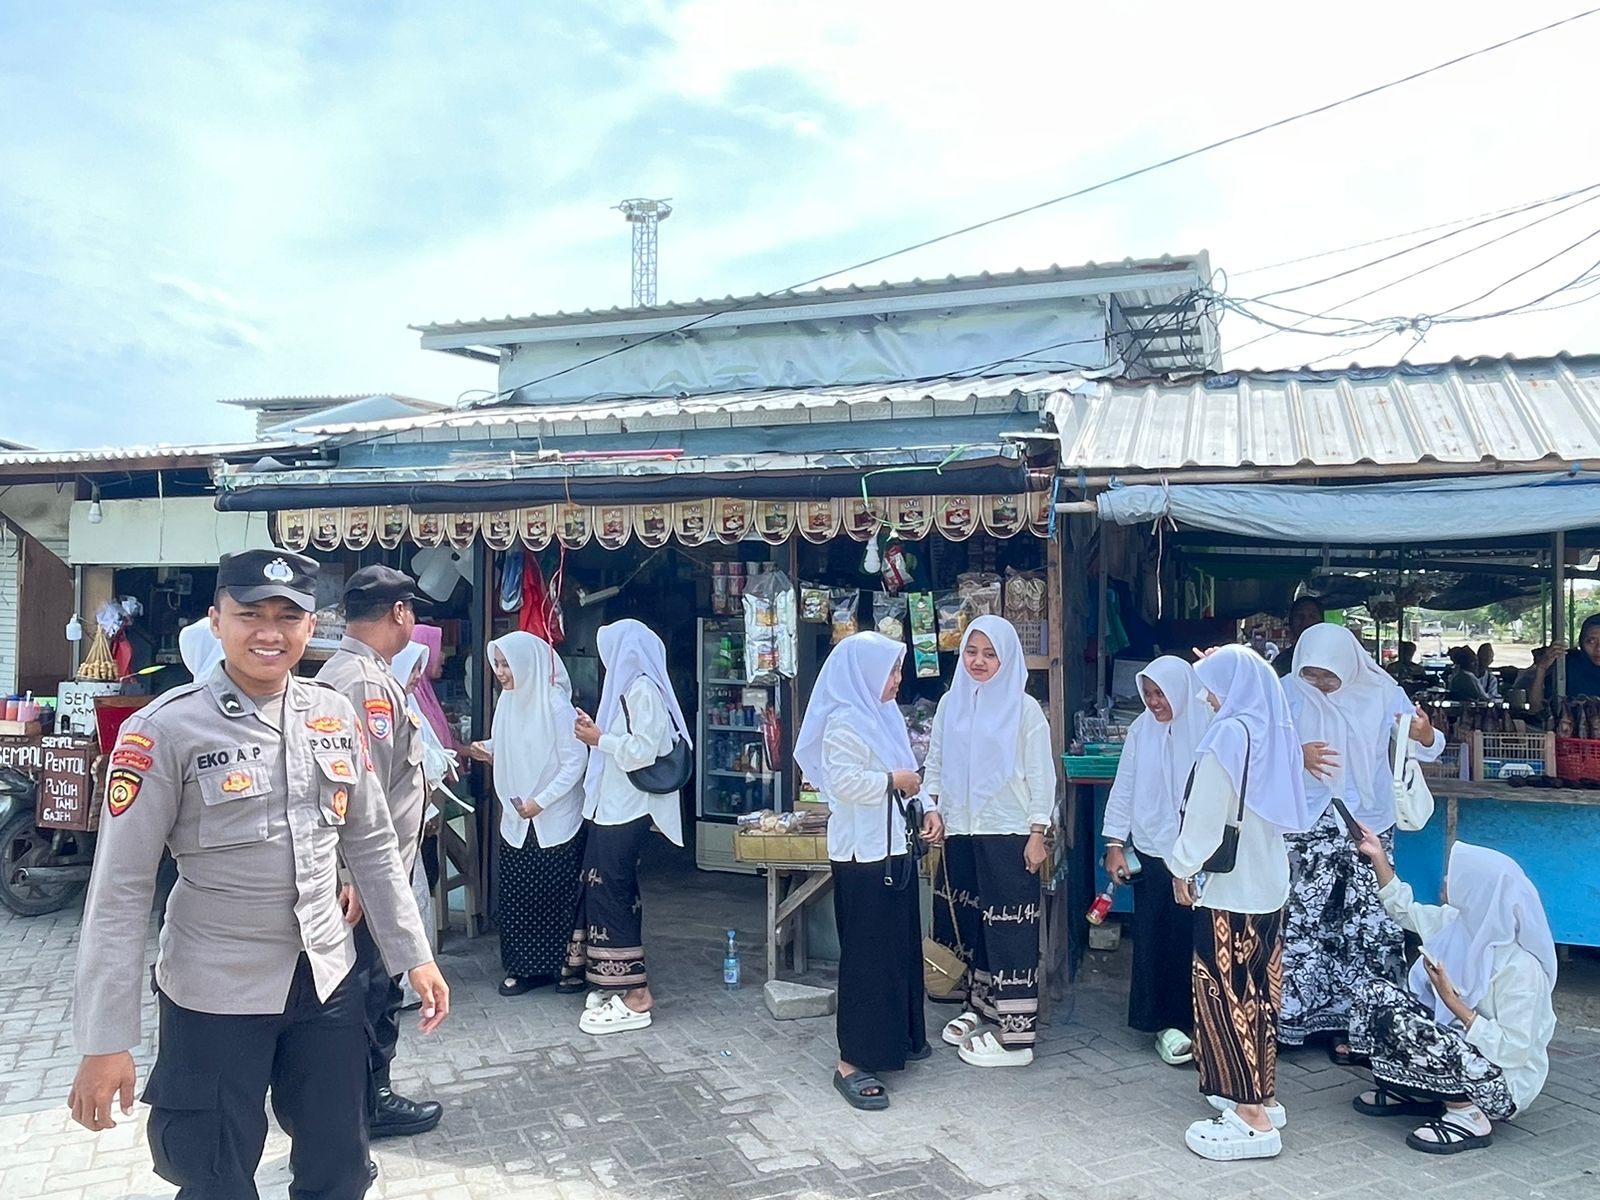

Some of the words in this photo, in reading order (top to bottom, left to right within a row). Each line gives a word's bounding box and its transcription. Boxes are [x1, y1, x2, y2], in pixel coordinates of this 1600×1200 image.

[64, 691, 96, 705] SEM
[41, 736, 74, 750] SEMPOL
[309, 737, 352, 751] POLRI
[45, 751, 86, 776] PENTOL
[197, 751, 229, 769] EKO
[237, 748, 247, 762] A
[252, 746, 261, 759] P
[53, 797, 78, 811] TAHU
